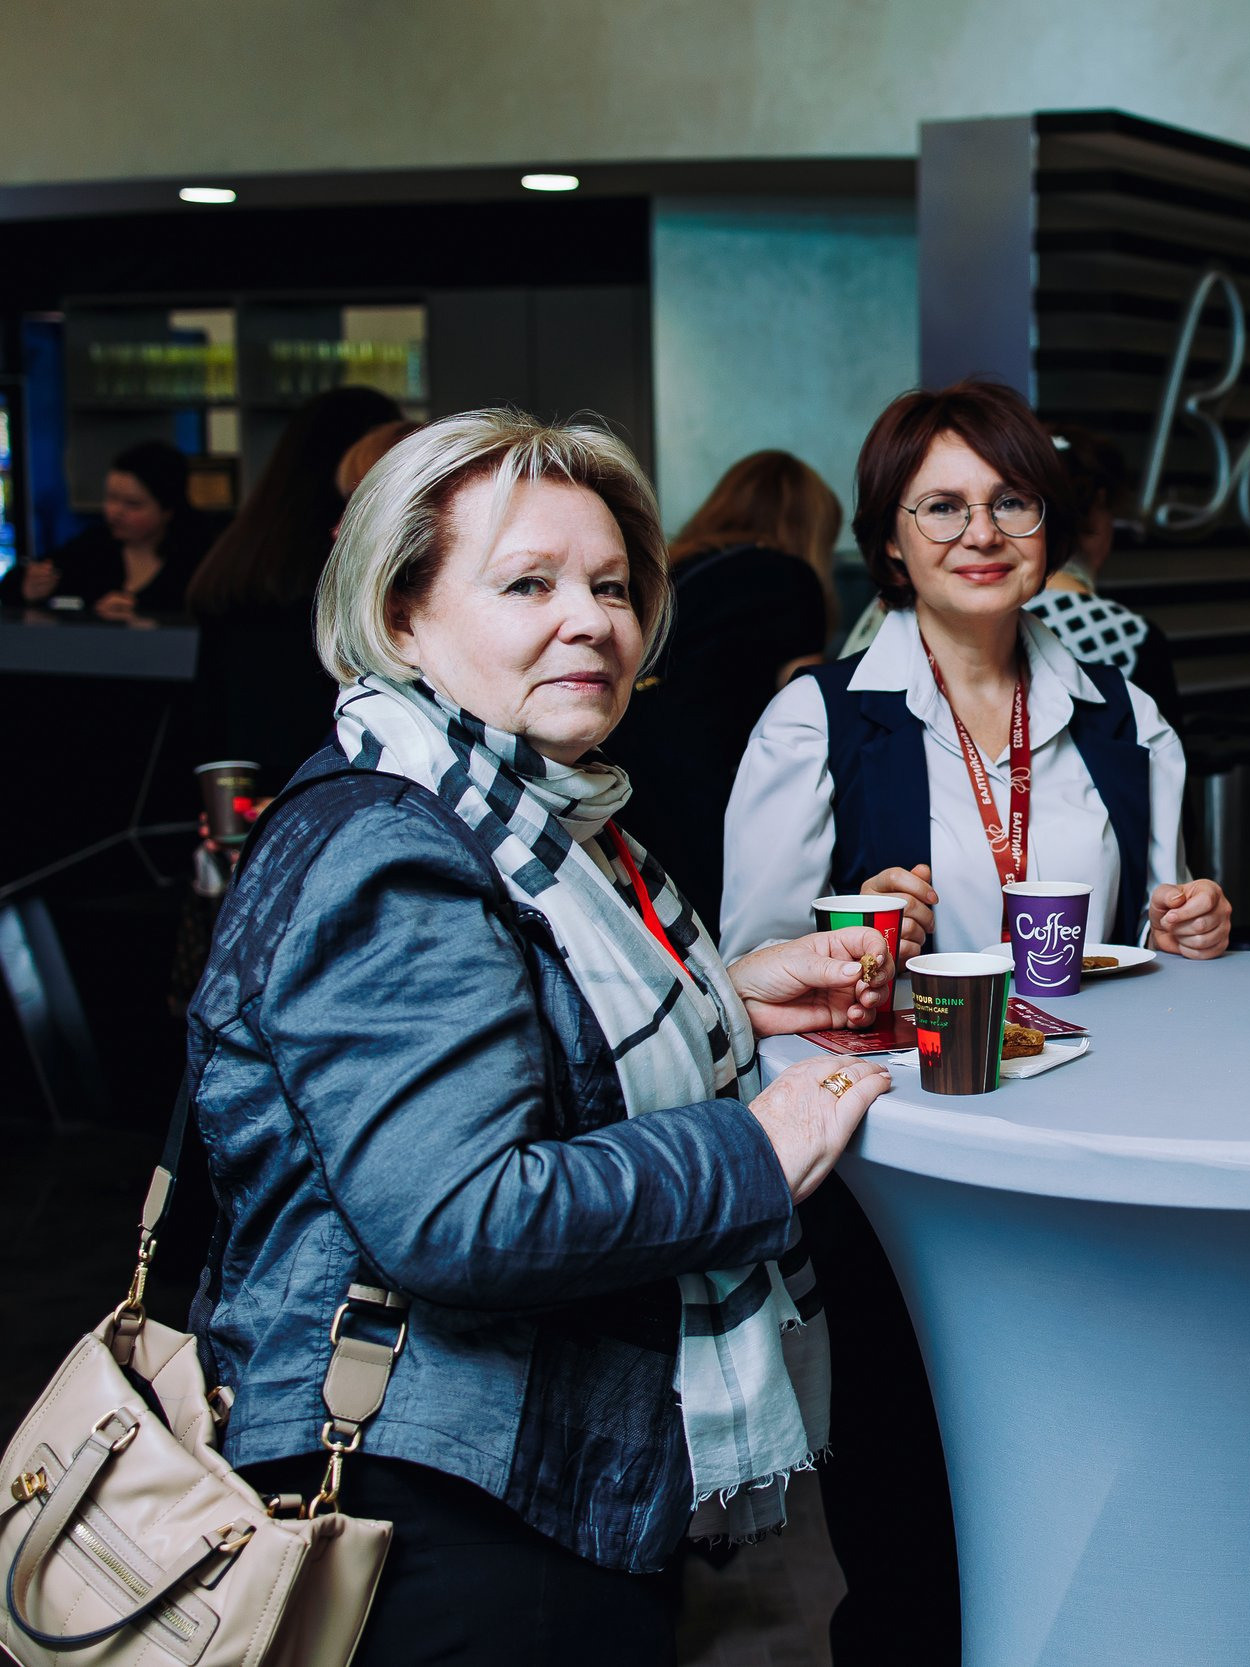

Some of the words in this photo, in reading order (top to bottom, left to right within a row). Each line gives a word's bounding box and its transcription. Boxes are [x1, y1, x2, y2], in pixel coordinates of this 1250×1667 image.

[1013, 727, 1023, 749] 2023
[1016, 912, 1081, 955] Coffee
[916, 995, 933, 1004] YOUR
[936, 998, 964, 1006] DRINK
